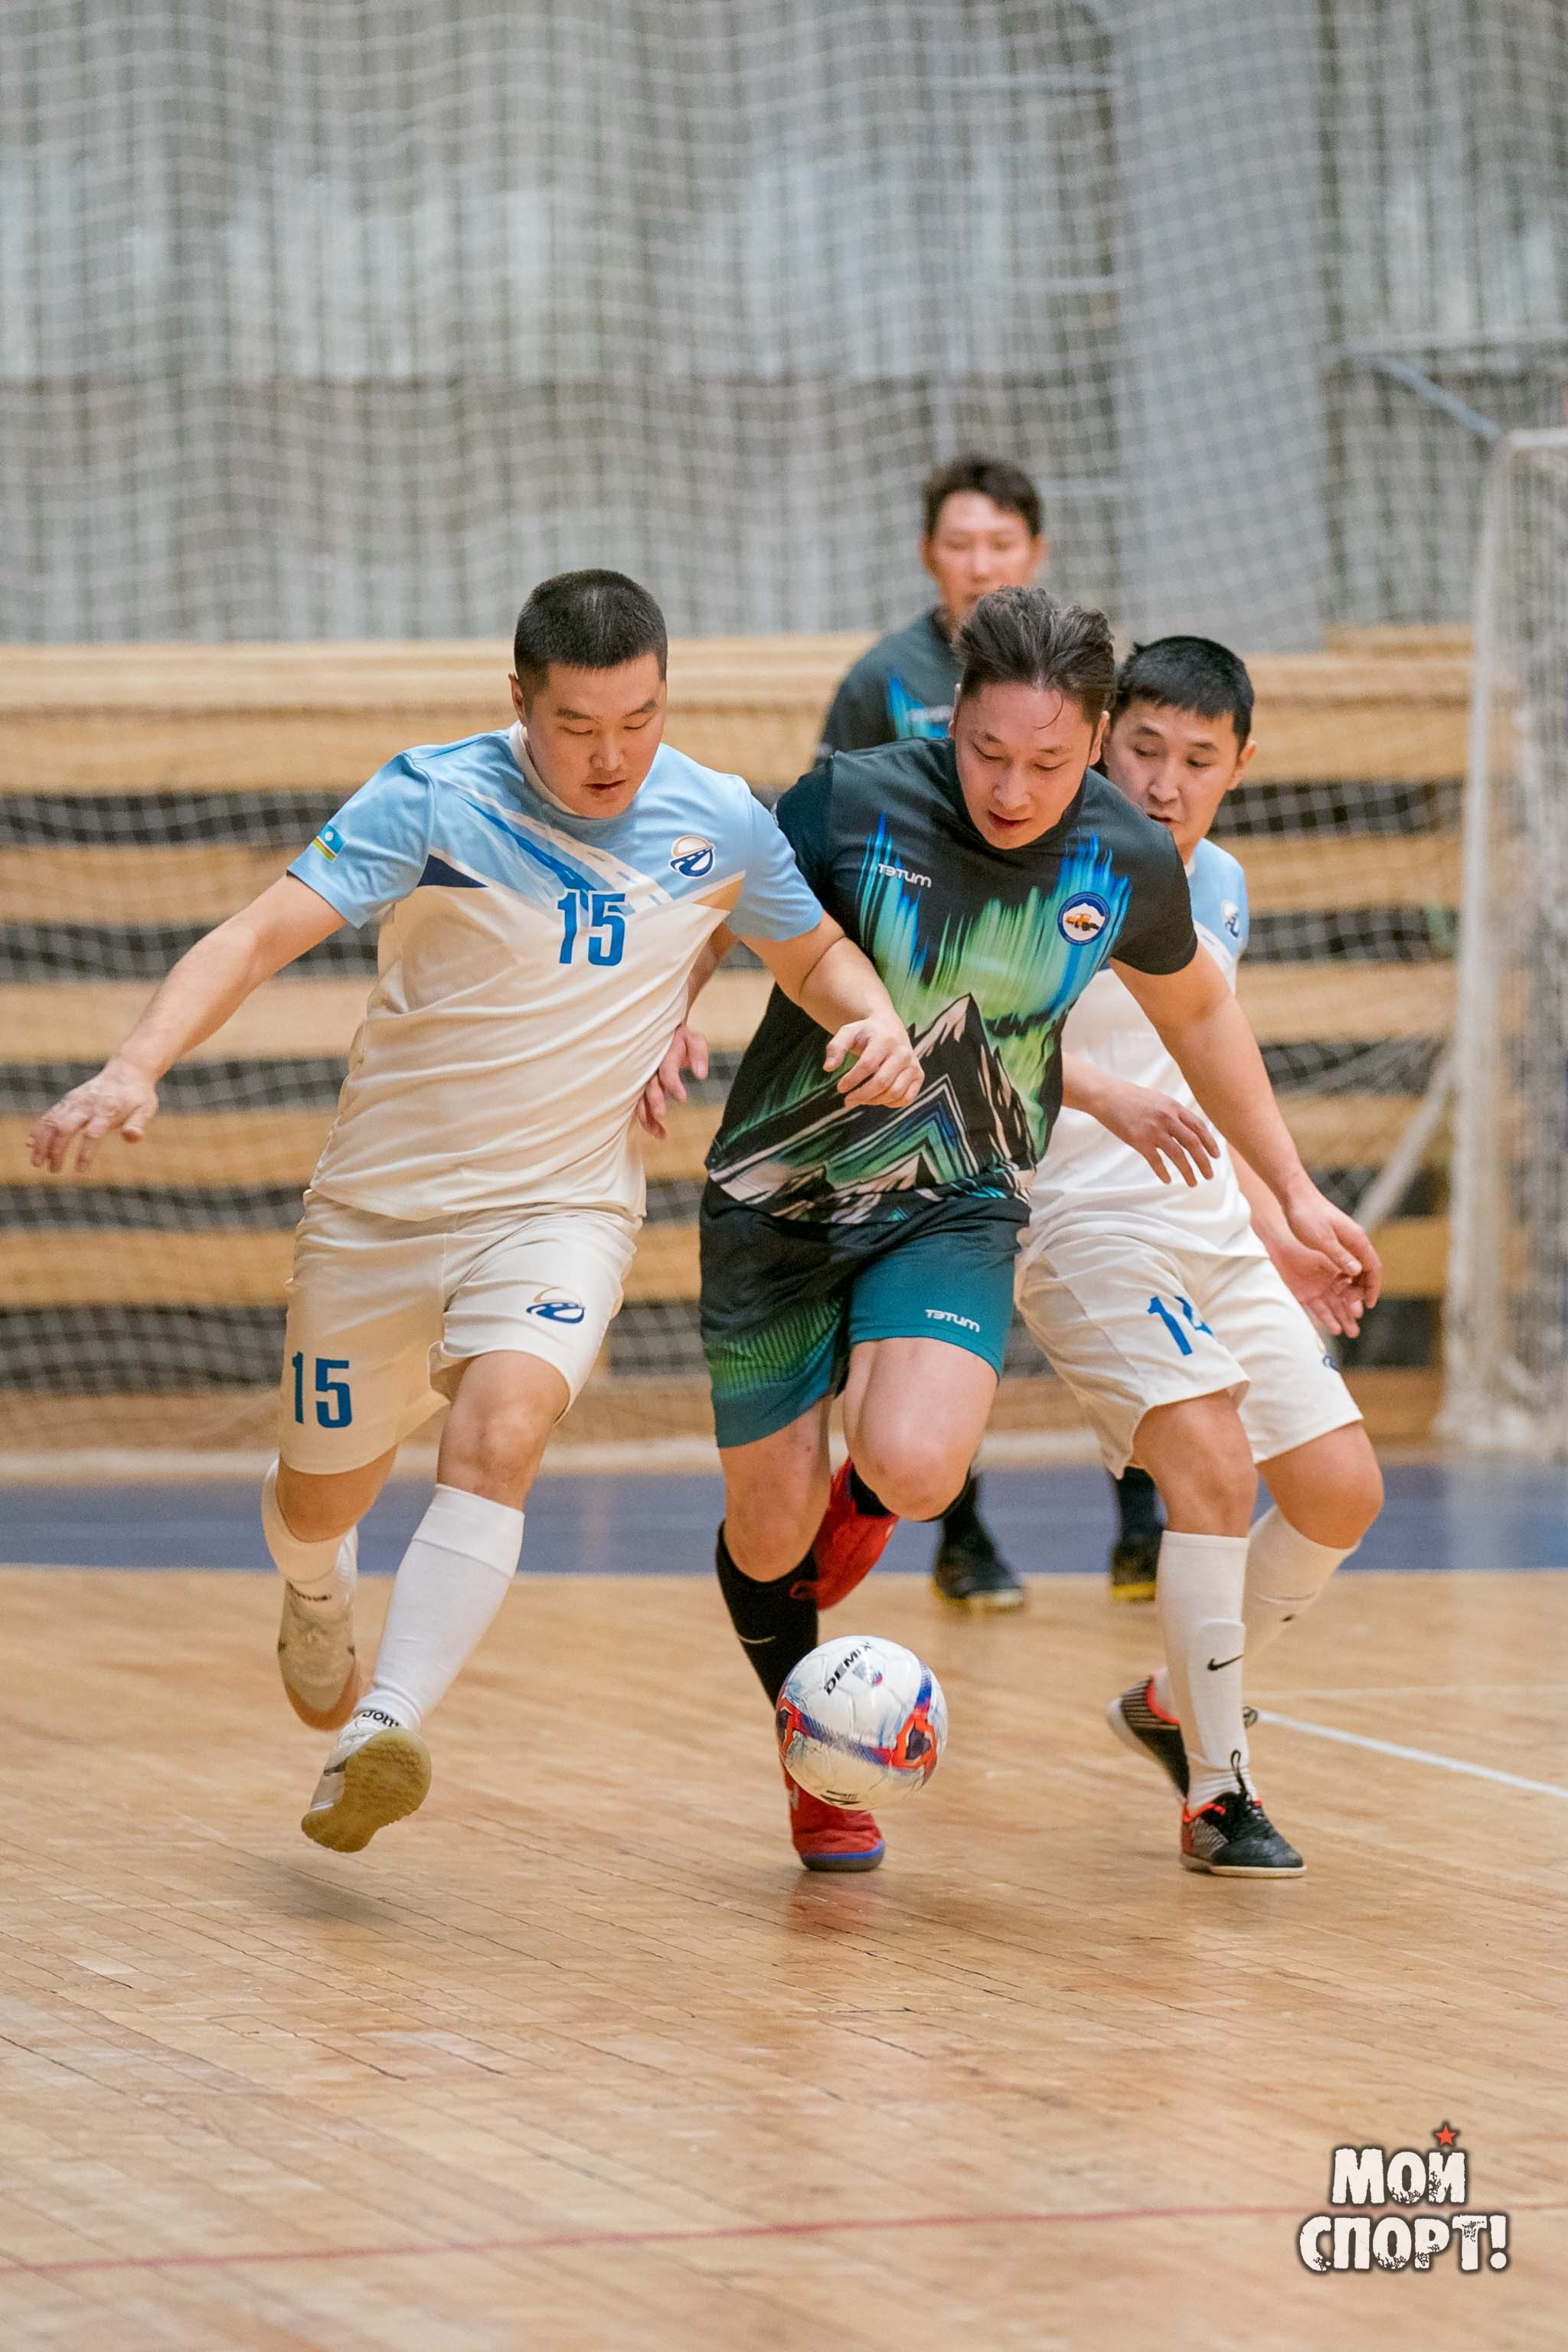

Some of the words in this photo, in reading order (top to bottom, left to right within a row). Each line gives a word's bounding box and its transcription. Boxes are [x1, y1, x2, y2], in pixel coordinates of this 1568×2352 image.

[556, 890, 627, 967] 15
[292, 1351, 352, 1429] 15
[361, 1709, 400, 1728] Jom
